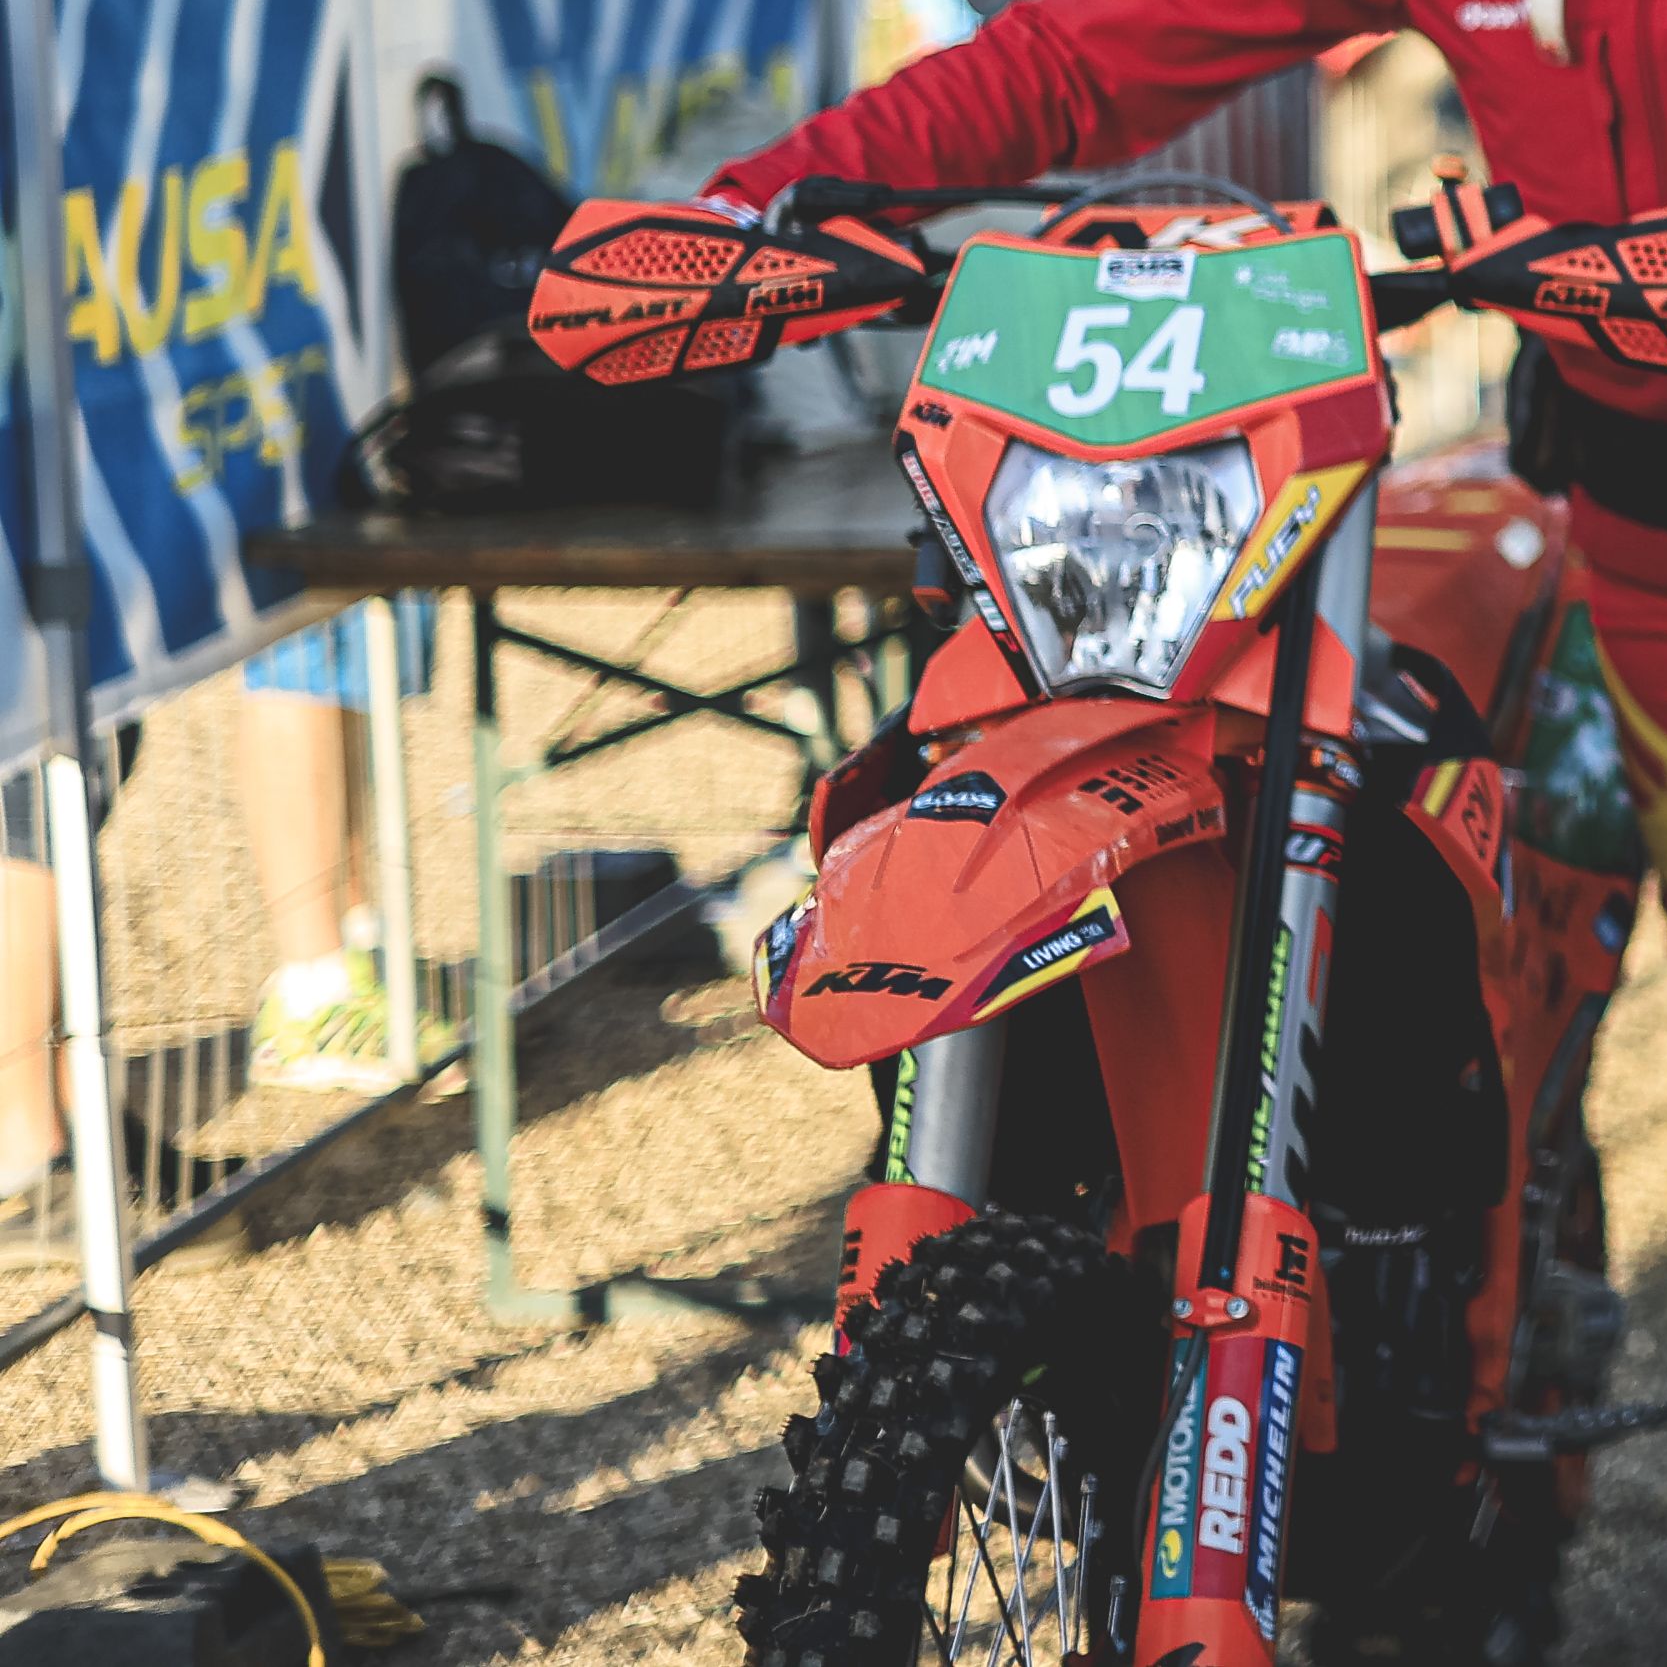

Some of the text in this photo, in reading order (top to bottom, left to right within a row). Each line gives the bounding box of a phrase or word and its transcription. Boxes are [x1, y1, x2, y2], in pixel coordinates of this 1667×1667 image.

[1046, 304, 1206, 419] 54
[800, 961, 954, 1003] KTM
[1022, 930, 1083, 970] LIVING
[1198, 1394, 1252, 1555] REDD
[1256, 1343, 1298, 1584] MICHELIN
